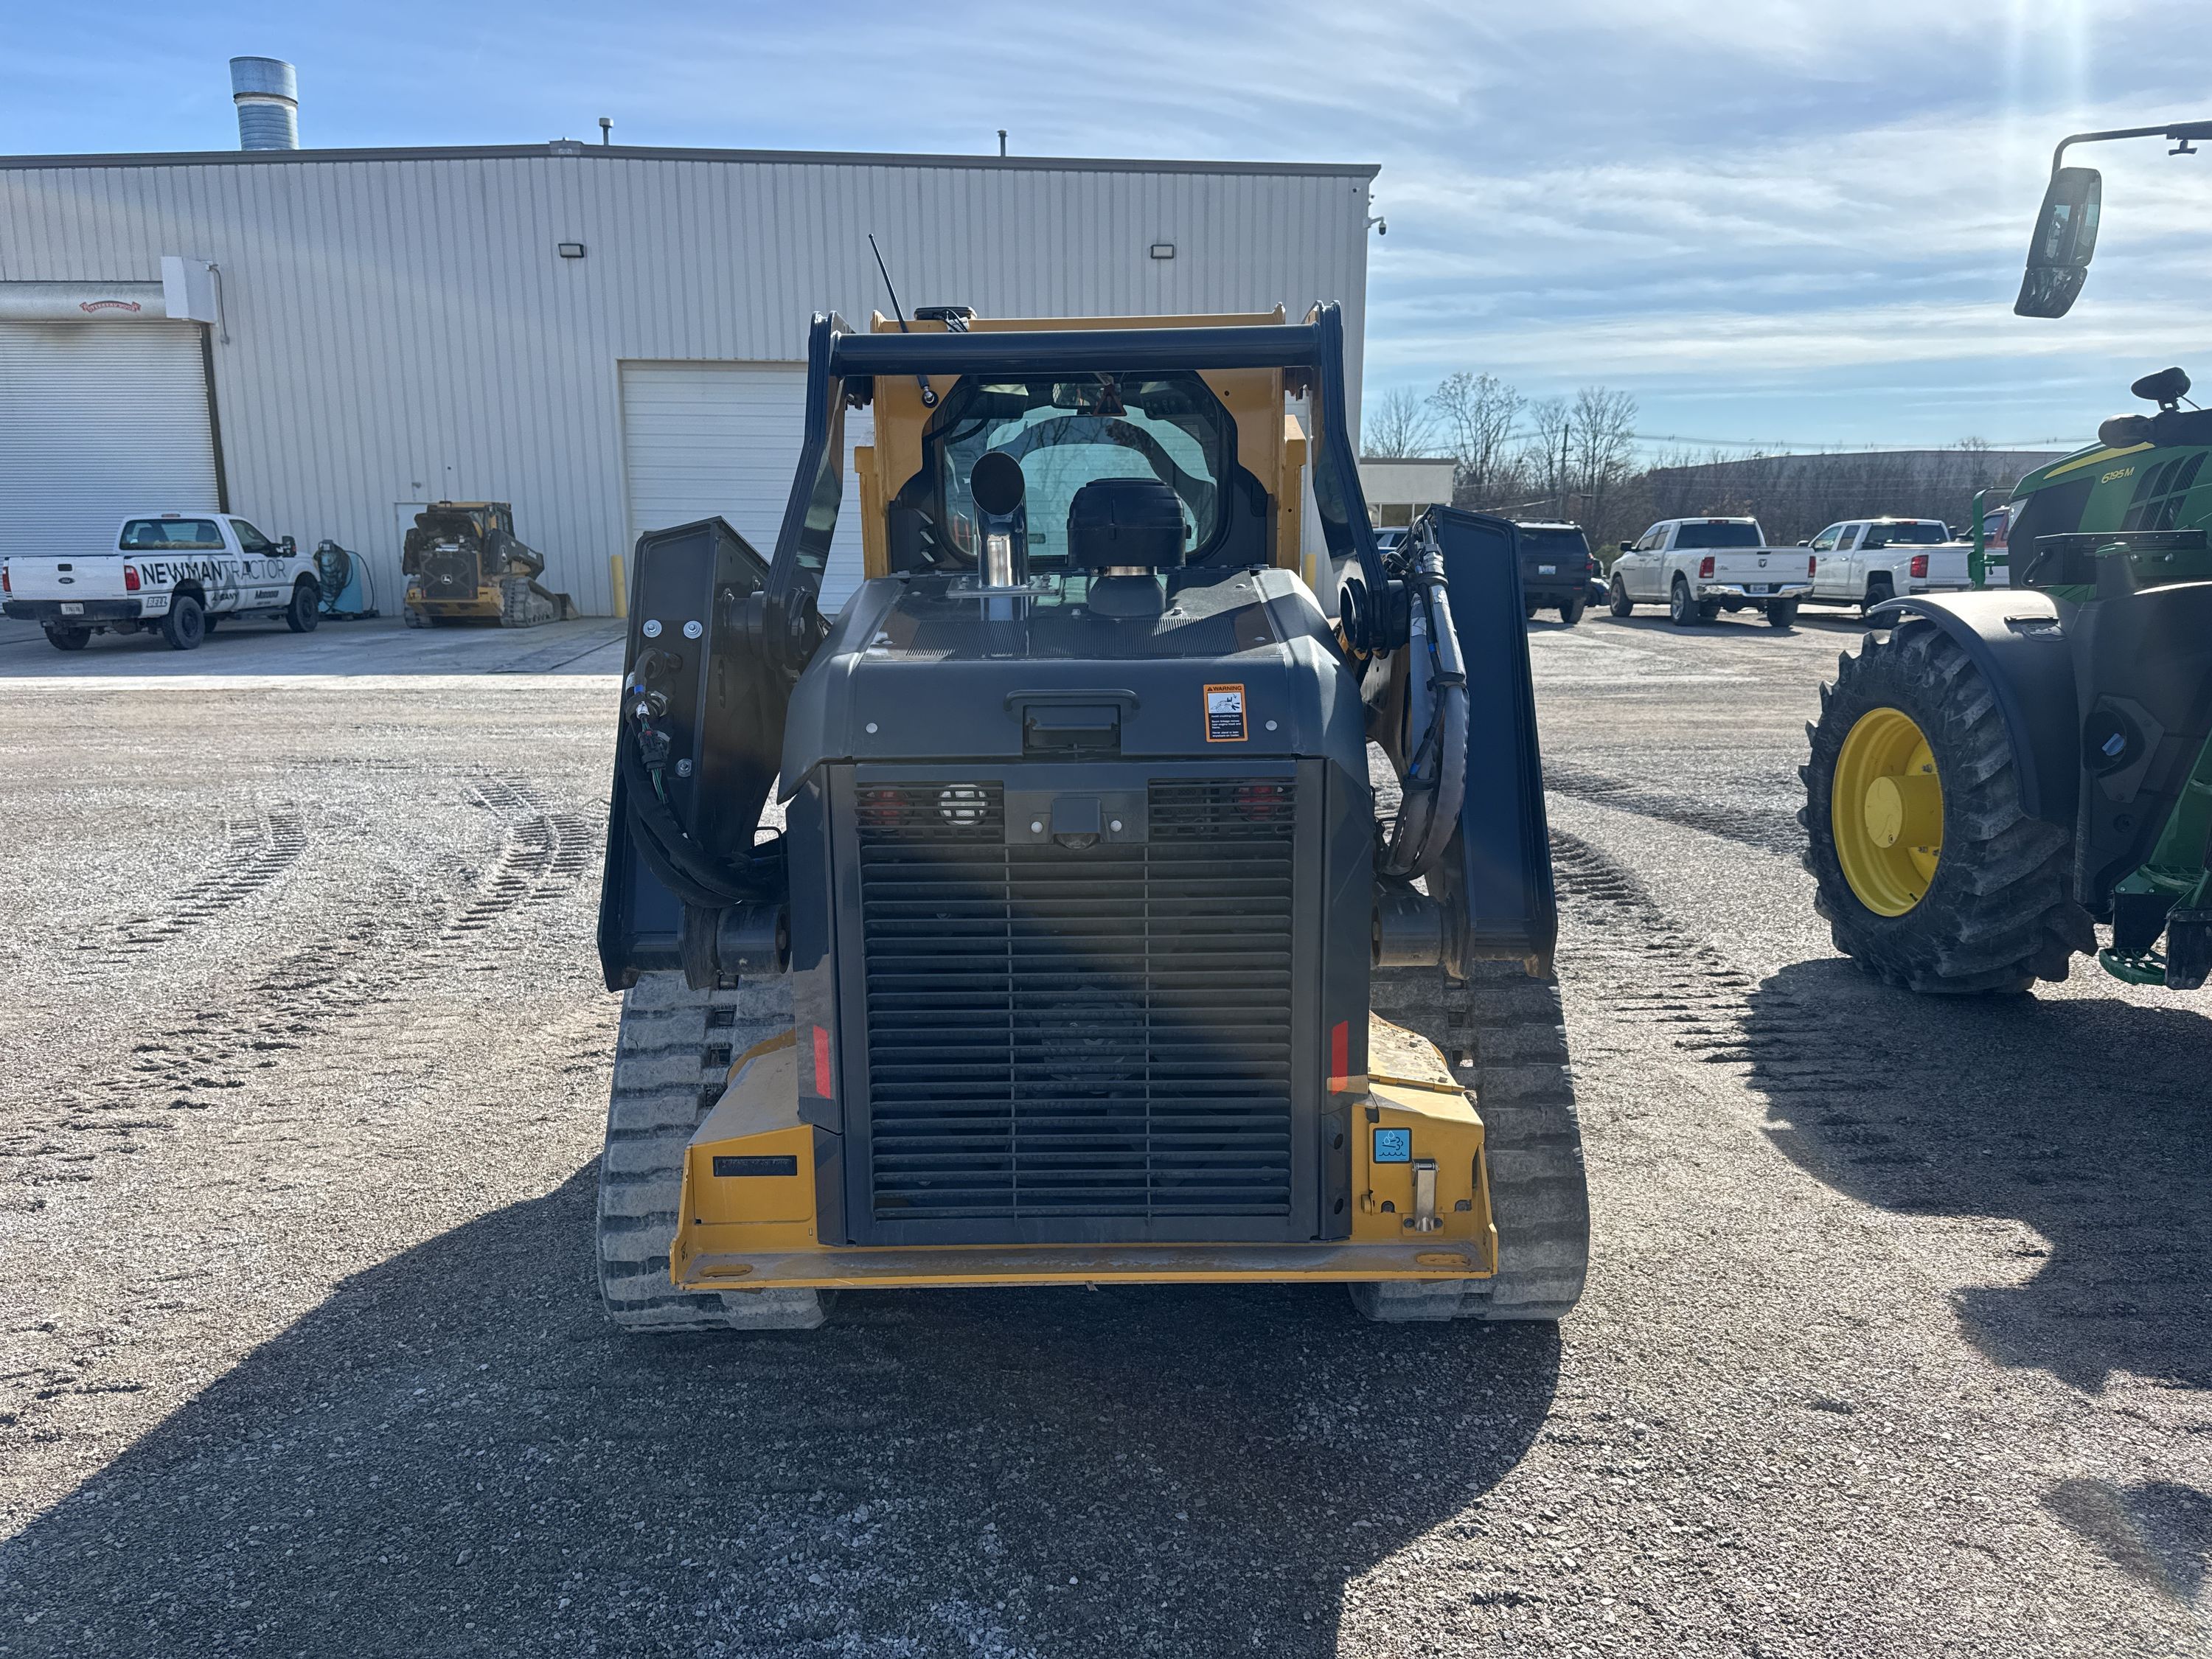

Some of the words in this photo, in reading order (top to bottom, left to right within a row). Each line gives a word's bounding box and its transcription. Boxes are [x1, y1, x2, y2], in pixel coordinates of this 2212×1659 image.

[2101, 466, 2135, 484] 6195M
[141, 560, 223, 585] NEWMAN
[222, 559, 286, 580] TRACTOR
[147, 597, 167, 608] BELL
